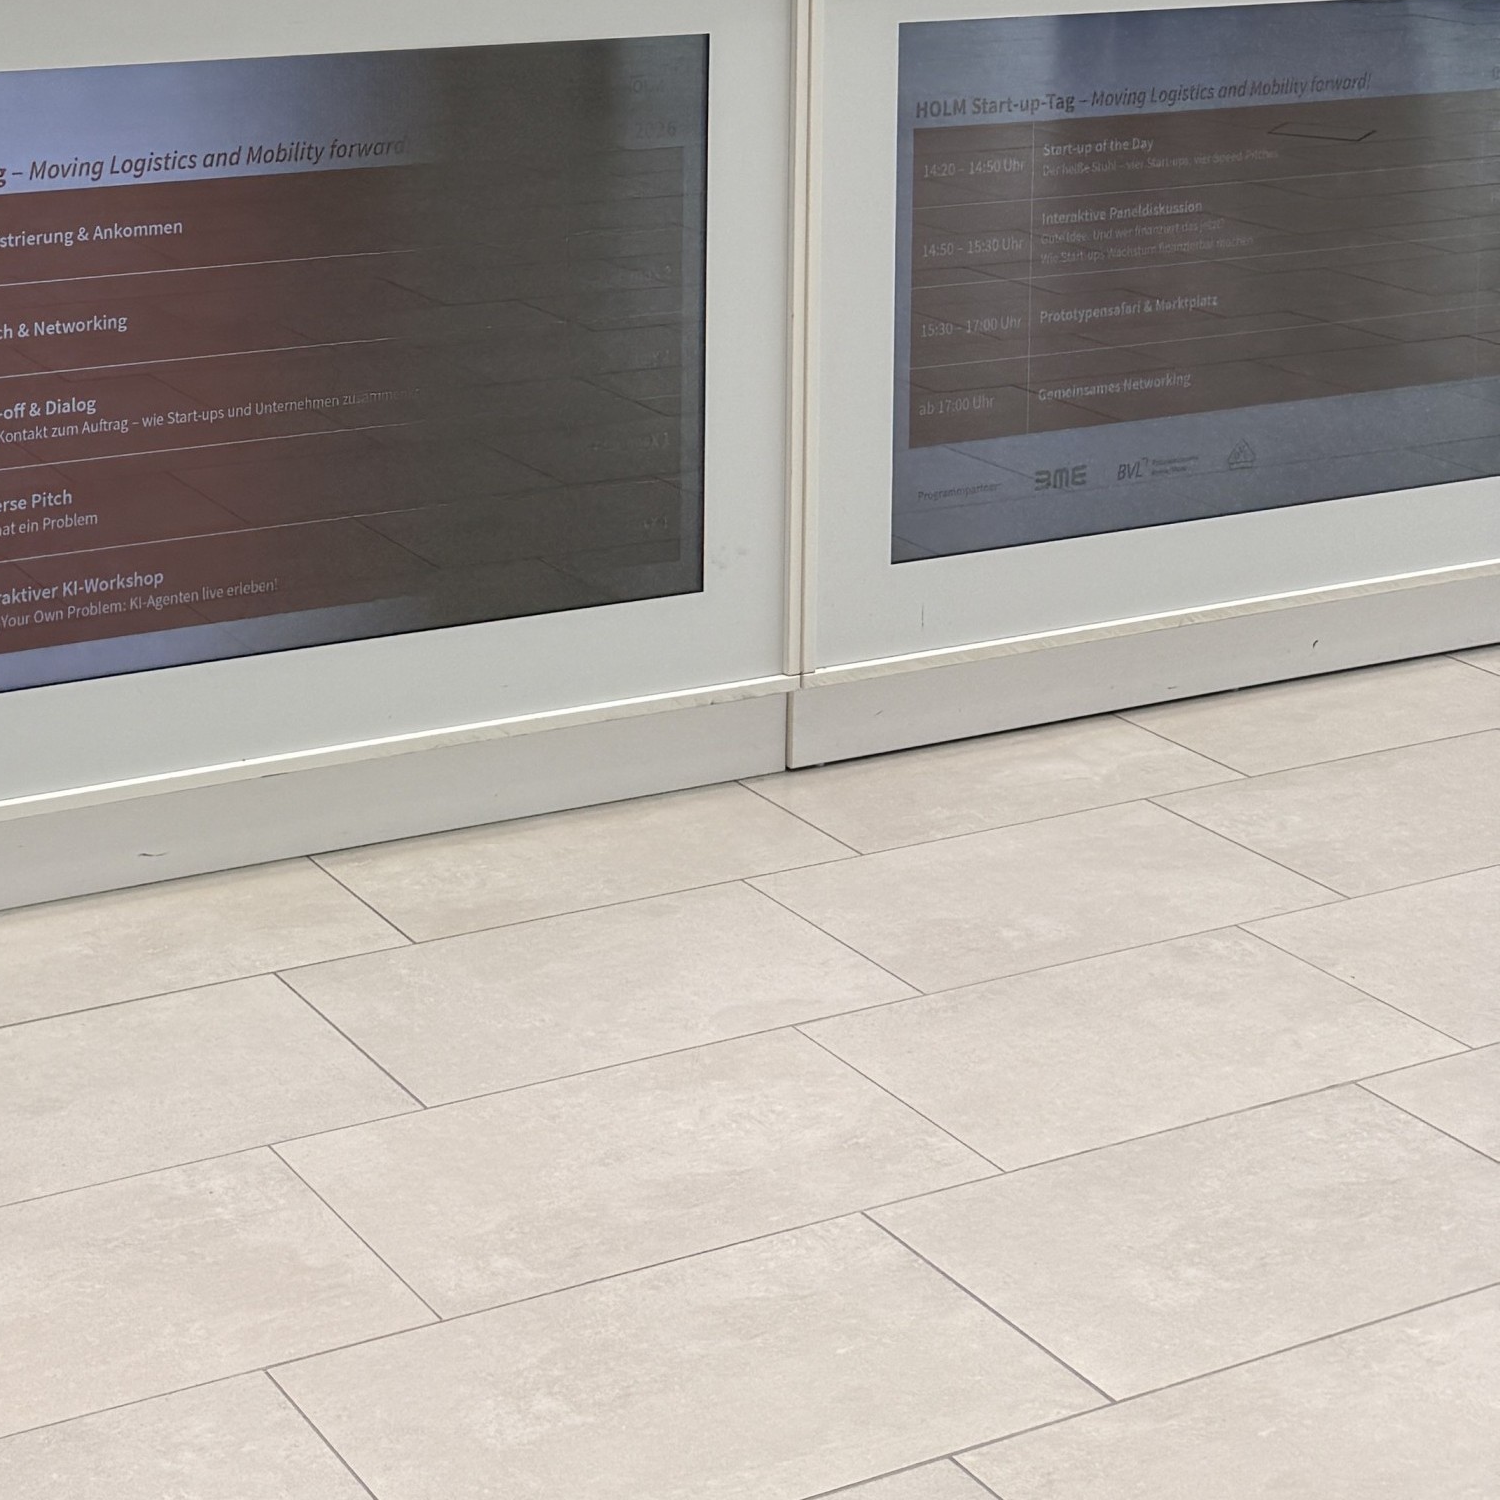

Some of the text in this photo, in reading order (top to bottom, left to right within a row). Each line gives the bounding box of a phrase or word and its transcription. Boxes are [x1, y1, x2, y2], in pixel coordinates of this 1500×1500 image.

[915, 100, 967, 119] HOLM
[971, 93, 1076, 116] Start-up-Tag
[1090, 88, 1147, 109] Moving
[1150, 84, 1215, 107] Logistics
[1217, 79, 1249, 98] and
[1250, 76, 1309, 98] Mobility
[1310, 71, 1373, 92] forward!
[1043, 137, 1155, 159] Start-up of the Day
[29, 156, 104, 182] Moving
[109, 150, 198, 178] Logistics
[202, 146, 243, 169] and
[246, 141, 325, 167] Mobility
[922, 162, 957, 179] 14:20
[967, 158, 1001, 176] 14:50
[1002, 157, 1026, 173] Uhr
[1042, 200, 1203, 226] Interaktive Paneldiskussion
[77, 226, 89, 243] &
[92, 220, 184, 242] Ankommen
[921, 241, 955, 258] 14:50
[966, 238, 999, 255] 15:30
[1001, 236, 1024, 251] Uhr
[1039, 303, 1141, 326] Prototypensafari
[1155, 295, 1219, 312] Marktplatz
[17, 322, 30, 338] &
[33, 314, 129, 337] Networking
[920, 322, 954, 338] 15:30
[965, 317, 998, 334] 17:00
[1000, 315, 1023, 330] Uhr
[1038, 372, 1192, 402] Gemeinsames Networking
[29, 402, 41, 418] &
[45, 396, 98, 417] Dialog
[51, 424, 80, 438] zum
[81, 417, 130, 435] Auftrag
[141, 411, 165, 428] wie
[167, 408, 226, 427] Start-ups
[227, 402, 253, 419] und
[254, 395, 341, 417] Unternehmen
[918, 394, 995, 416] ab 17:00 Uhr
[31, 488, 73, 510] Pitch
[18, 517, 40, 535] ein
[42, 511, 99, 532] Problem
[61, 570, 165, 598] KI-Workshop
[0, 613, 31, 630] Your
[33, 607, 65, 624] Own
[67, 597, 128, 619] Problem:
[129, 588, 200, 612] KI-Agenten
[202, 584, 225, 601] live
[226, 577, 280, 599] erleben!
